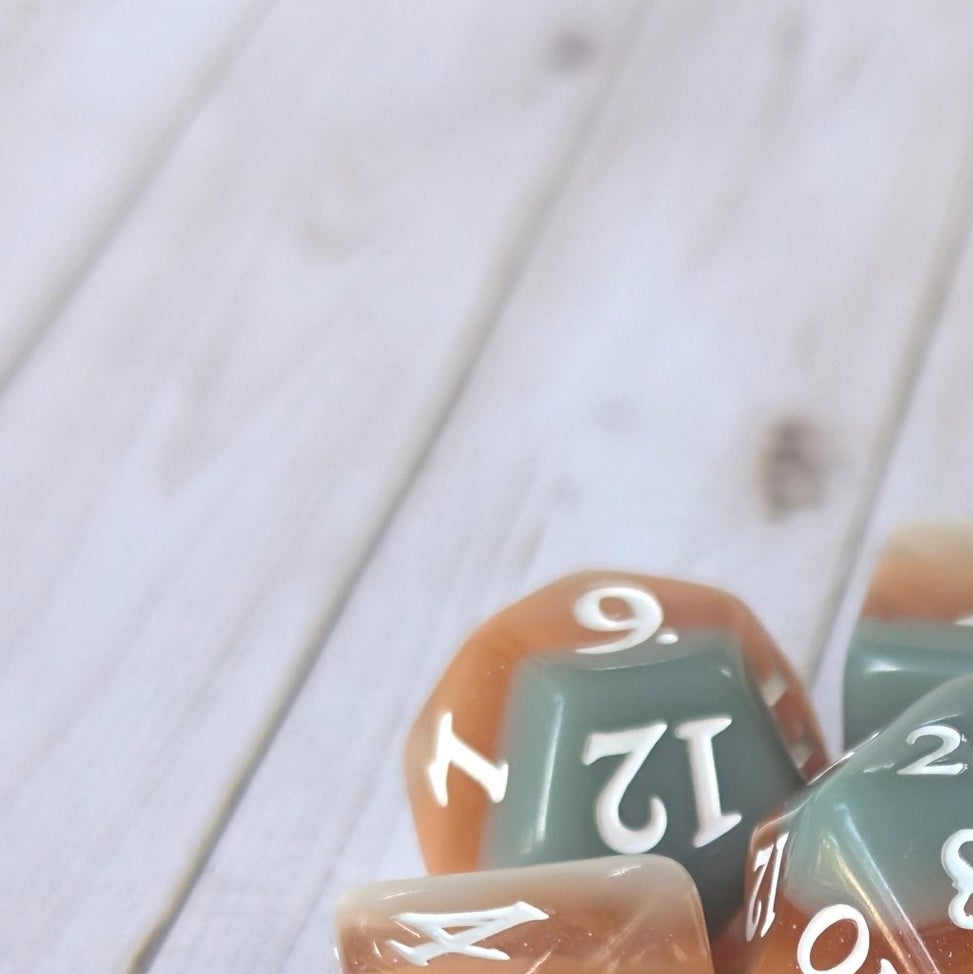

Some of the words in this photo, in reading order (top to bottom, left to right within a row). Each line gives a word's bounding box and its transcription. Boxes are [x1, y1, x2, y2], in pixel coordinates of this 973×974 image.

[426, 710, 508, 807] 1
[582, 715, 742, 854] 12
[385, 900, 550, 967] 4
[746, 832, 790, 942] 12
